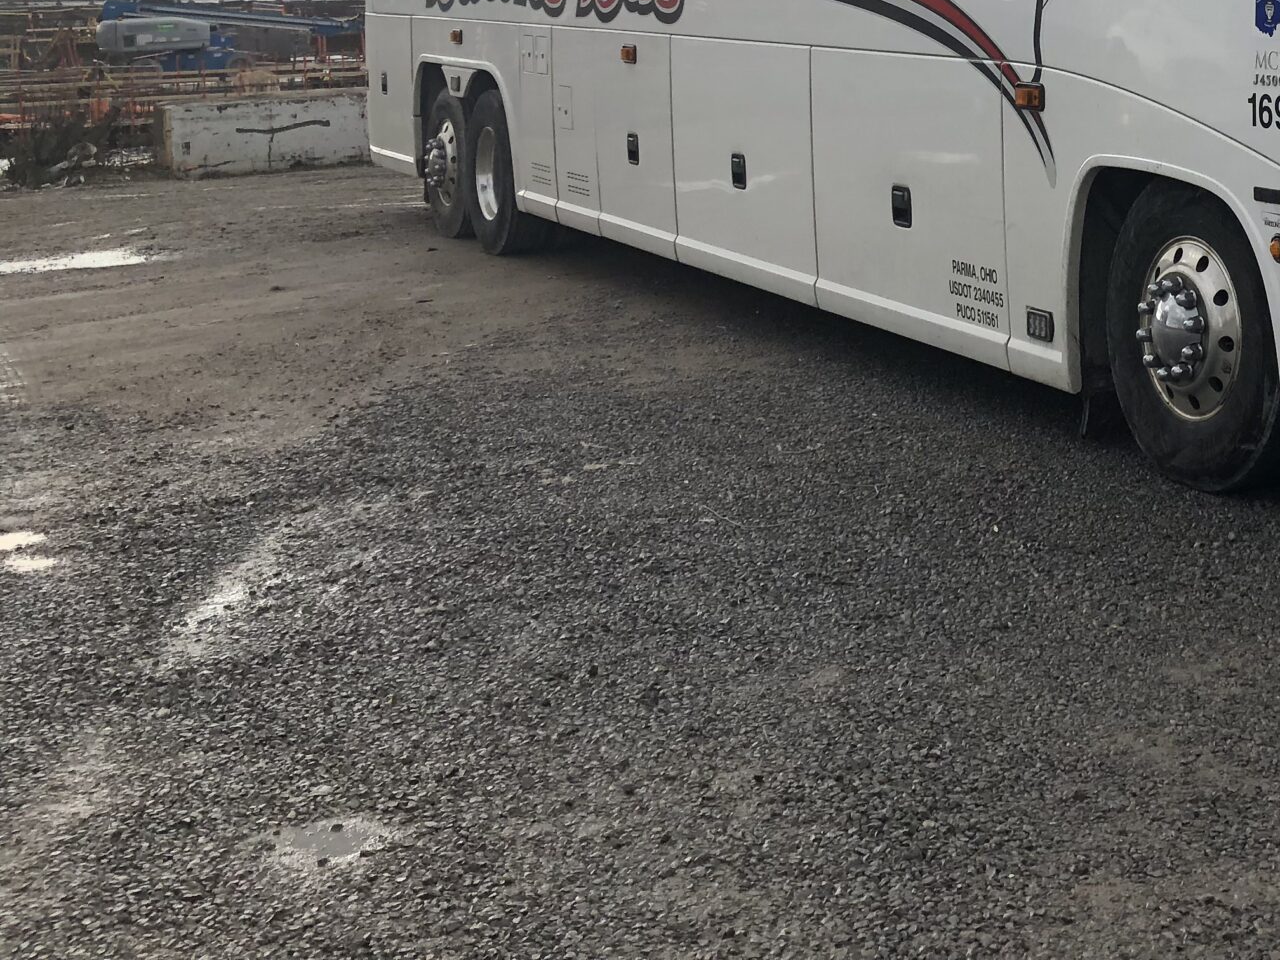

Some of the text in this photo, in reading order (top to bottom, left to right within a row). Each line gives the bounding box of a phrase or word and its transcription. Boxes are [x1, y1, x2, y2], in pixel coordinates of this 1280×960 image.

[980, 266, 998, 284] OHIO
[949, 280, 1004, 308] USDOT 2340455
[956, 302, 999, 328] PUCO 511561
